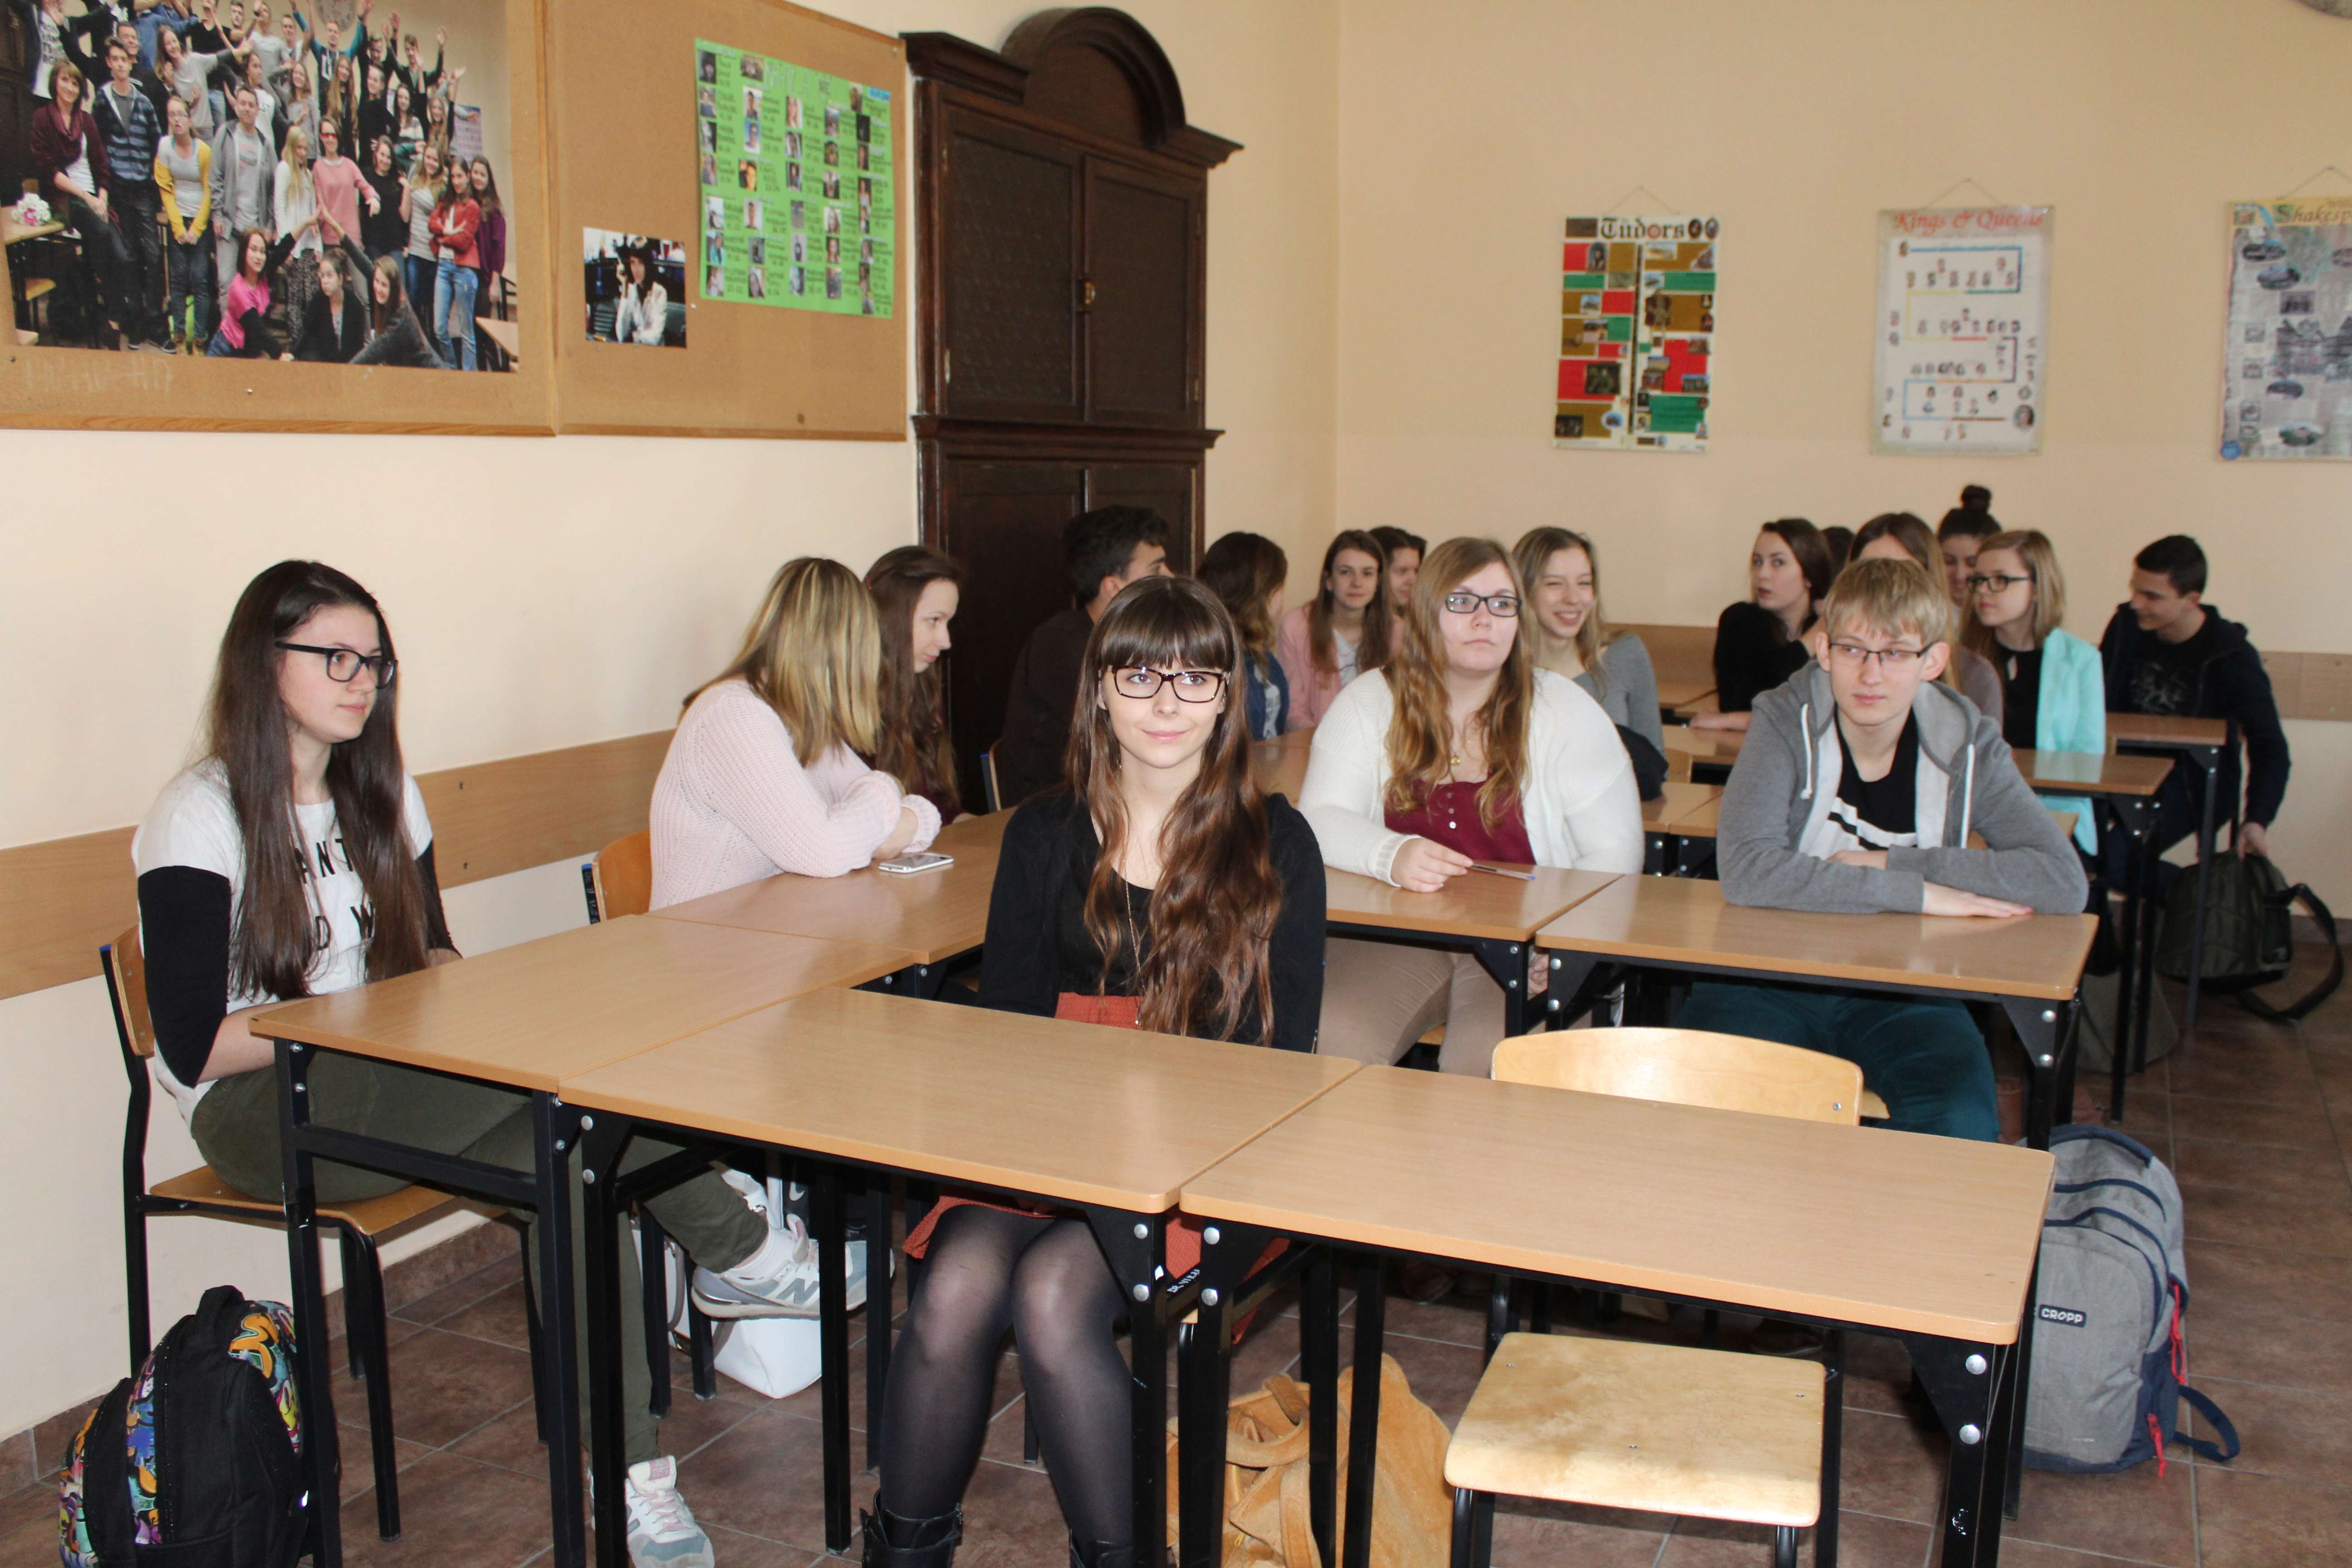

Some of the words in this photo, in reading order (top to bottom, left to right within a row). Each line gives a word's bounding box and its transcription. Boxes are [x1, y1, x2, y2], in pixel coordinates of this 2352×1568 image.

[1601, 217, 1685, 240] Tudors
[1893, 210, 1945, 236] Kings
[1976, 208, 2044, 232] Queens
[2041, 1308, 2083, 1323] CROPP
